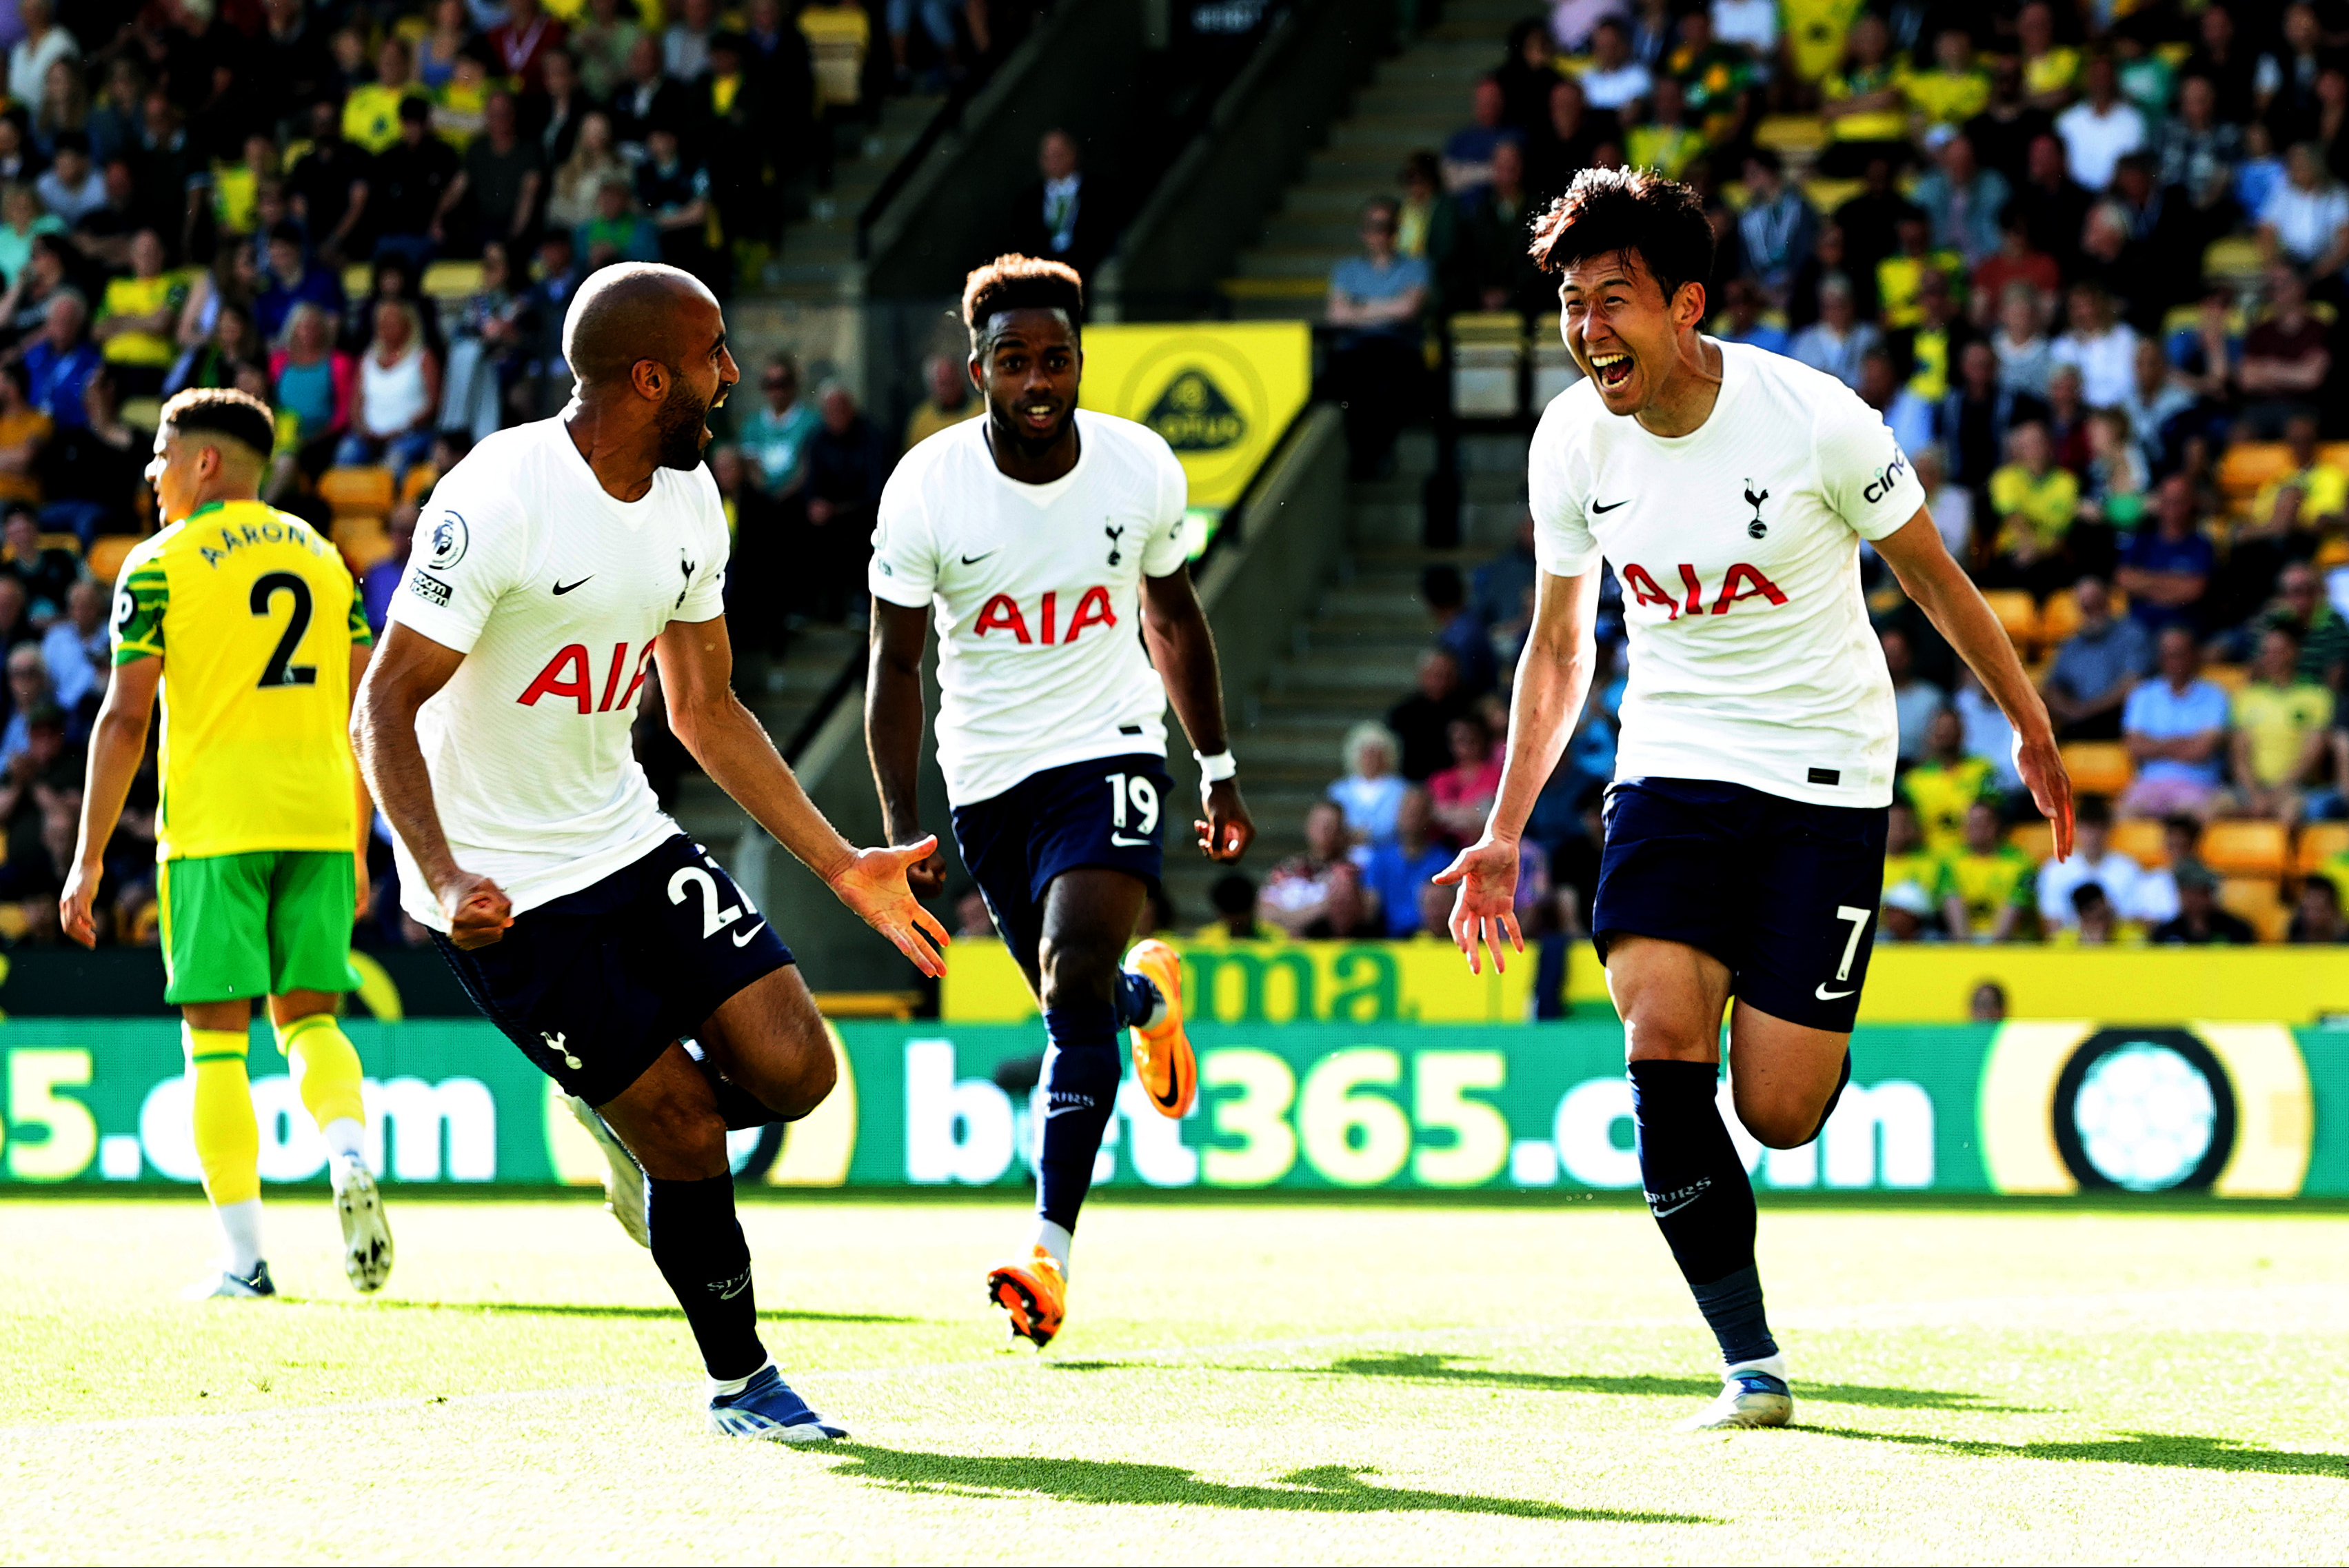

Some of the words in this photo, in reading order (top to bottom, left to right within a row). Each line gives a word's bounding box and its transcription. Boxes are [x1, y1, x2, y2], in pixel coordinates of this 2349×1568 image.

[1863, 448, 1905, 503] cinc
[974, 585, 1117, 645] AIA
[1623, 563, 1789, 621] AIA
[250, 572, 317, 690] 2
[1105, 772, 1160, 836] 19
[1835, 905, 1872, 981] 7
[1180, 946, 1420, 1021] ma
[1643, 1176, 1712, 1204] SPURS
